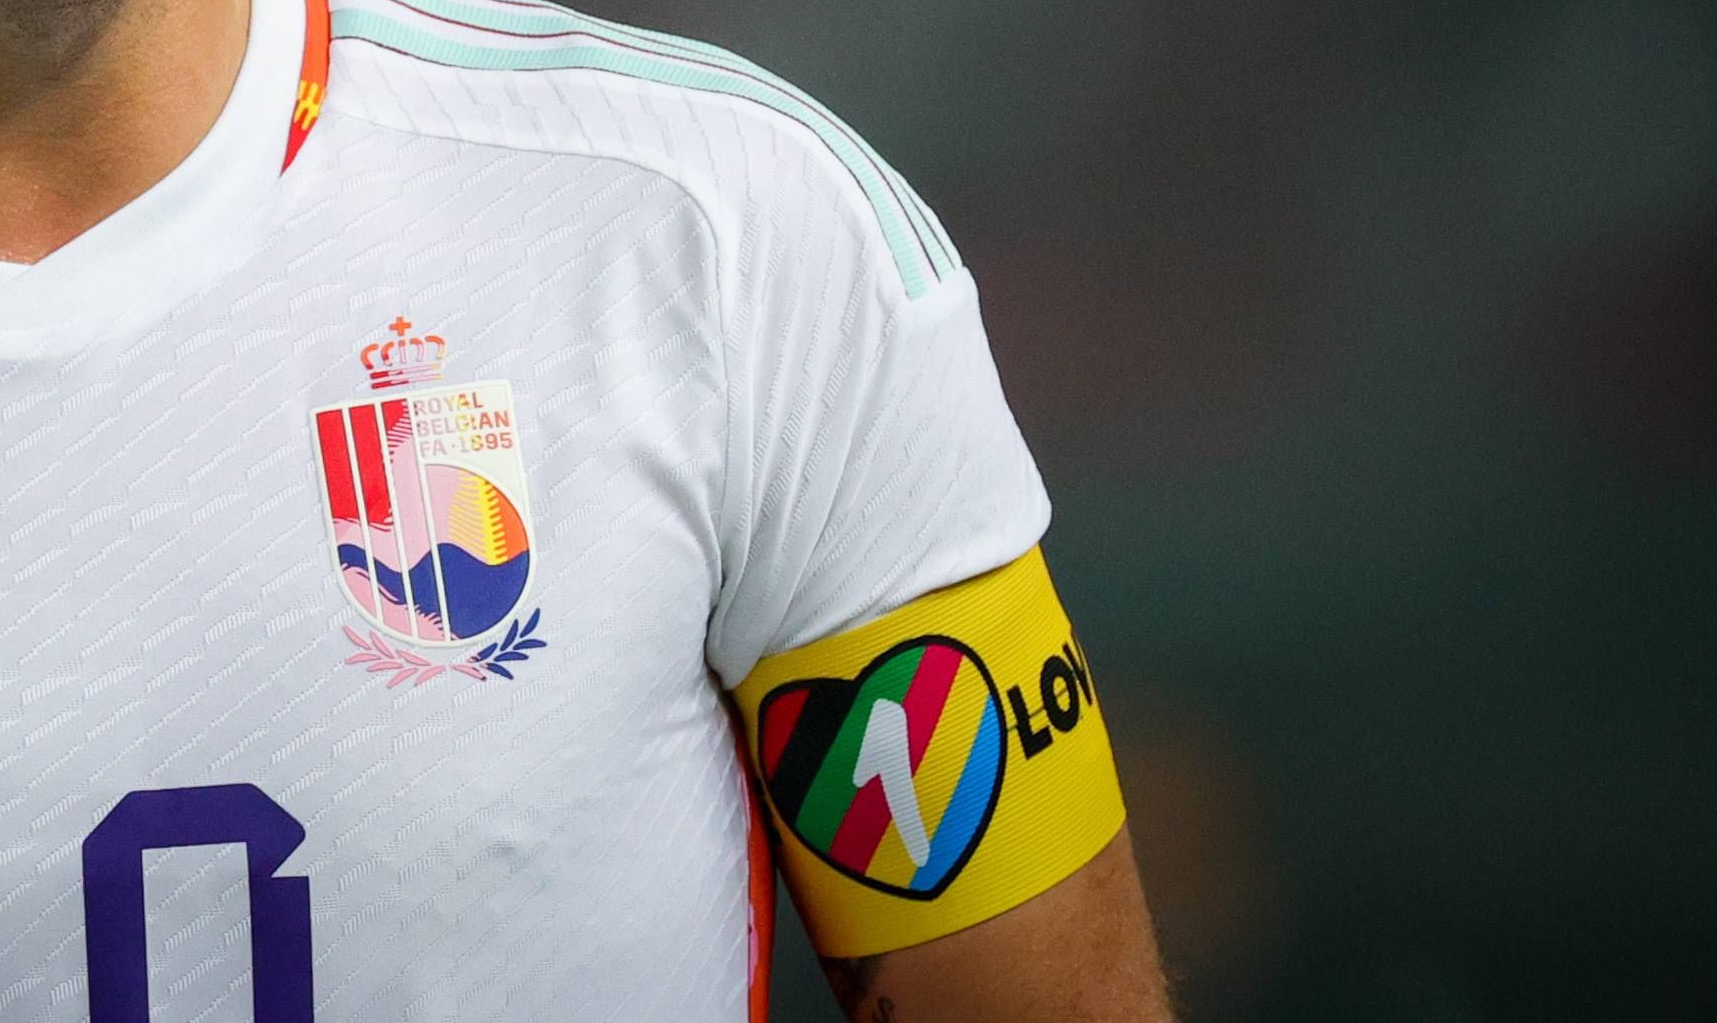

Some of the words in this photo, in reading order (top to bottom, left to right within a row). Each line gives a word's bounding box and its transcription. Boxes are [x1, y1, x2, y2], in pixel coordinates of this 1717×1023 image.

[413, 392, 483, 416] ROYAL
[416, 411, 510, 437] BELGIAN
[853, 698, 931, 867] 1
